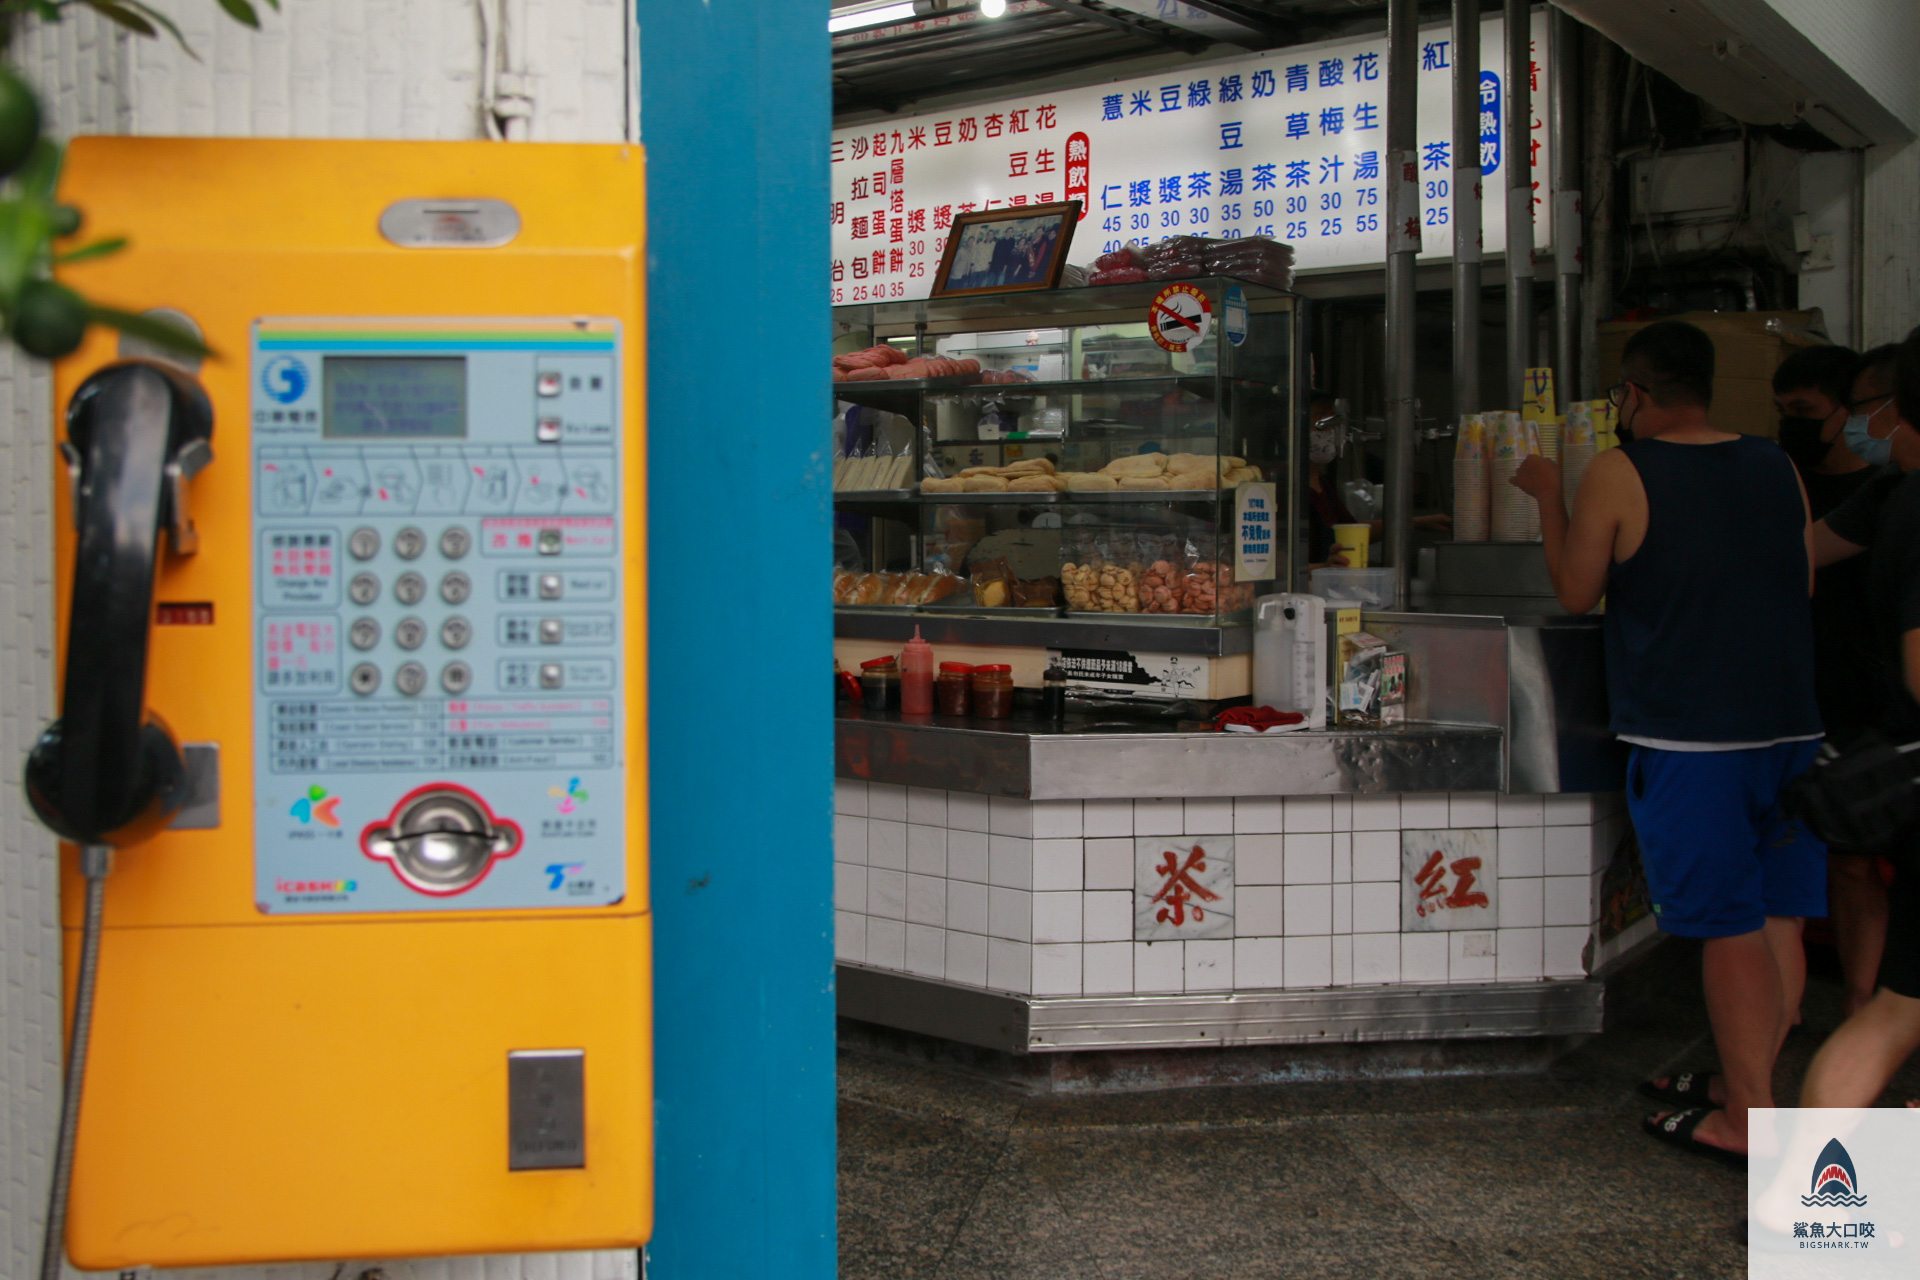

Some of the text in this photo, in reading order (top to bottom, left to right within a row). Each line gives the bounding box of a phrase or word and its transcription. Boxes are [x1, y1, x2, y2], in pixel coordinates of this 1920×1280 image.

[1218, 75, 1243, 197] 綠豆湯
[1352, 52, 1379, 233] 花生湯 75 55
[1285, 64, 1310, 239] 青草茶 30 25
[1318, 58, 1344, 236] 酸梅汁 30 25
[1425, 179, 1448, 199] 30
[1189, 206, 1209, 224] 30
[1221, 203, 1241, 221] 35
[1253, 199, 1273, 217] 50
[1425, 206, 1448, 226] 25
[1102, 216, 1121, 232] 45
[1130, 213, 1149, 230] 30
[1160, 210, 1179, 227] 30
[909, 240, 925, 256] 30
[909, 262, 925, 278] 25
[853, 286, 868, 301] 25
[872, 284, 886, 298] 40
[890, 282, 904, 297] 35
[1152, 845, 1223, 927] 茶
[1413, 850, 1489, 918] 紅
